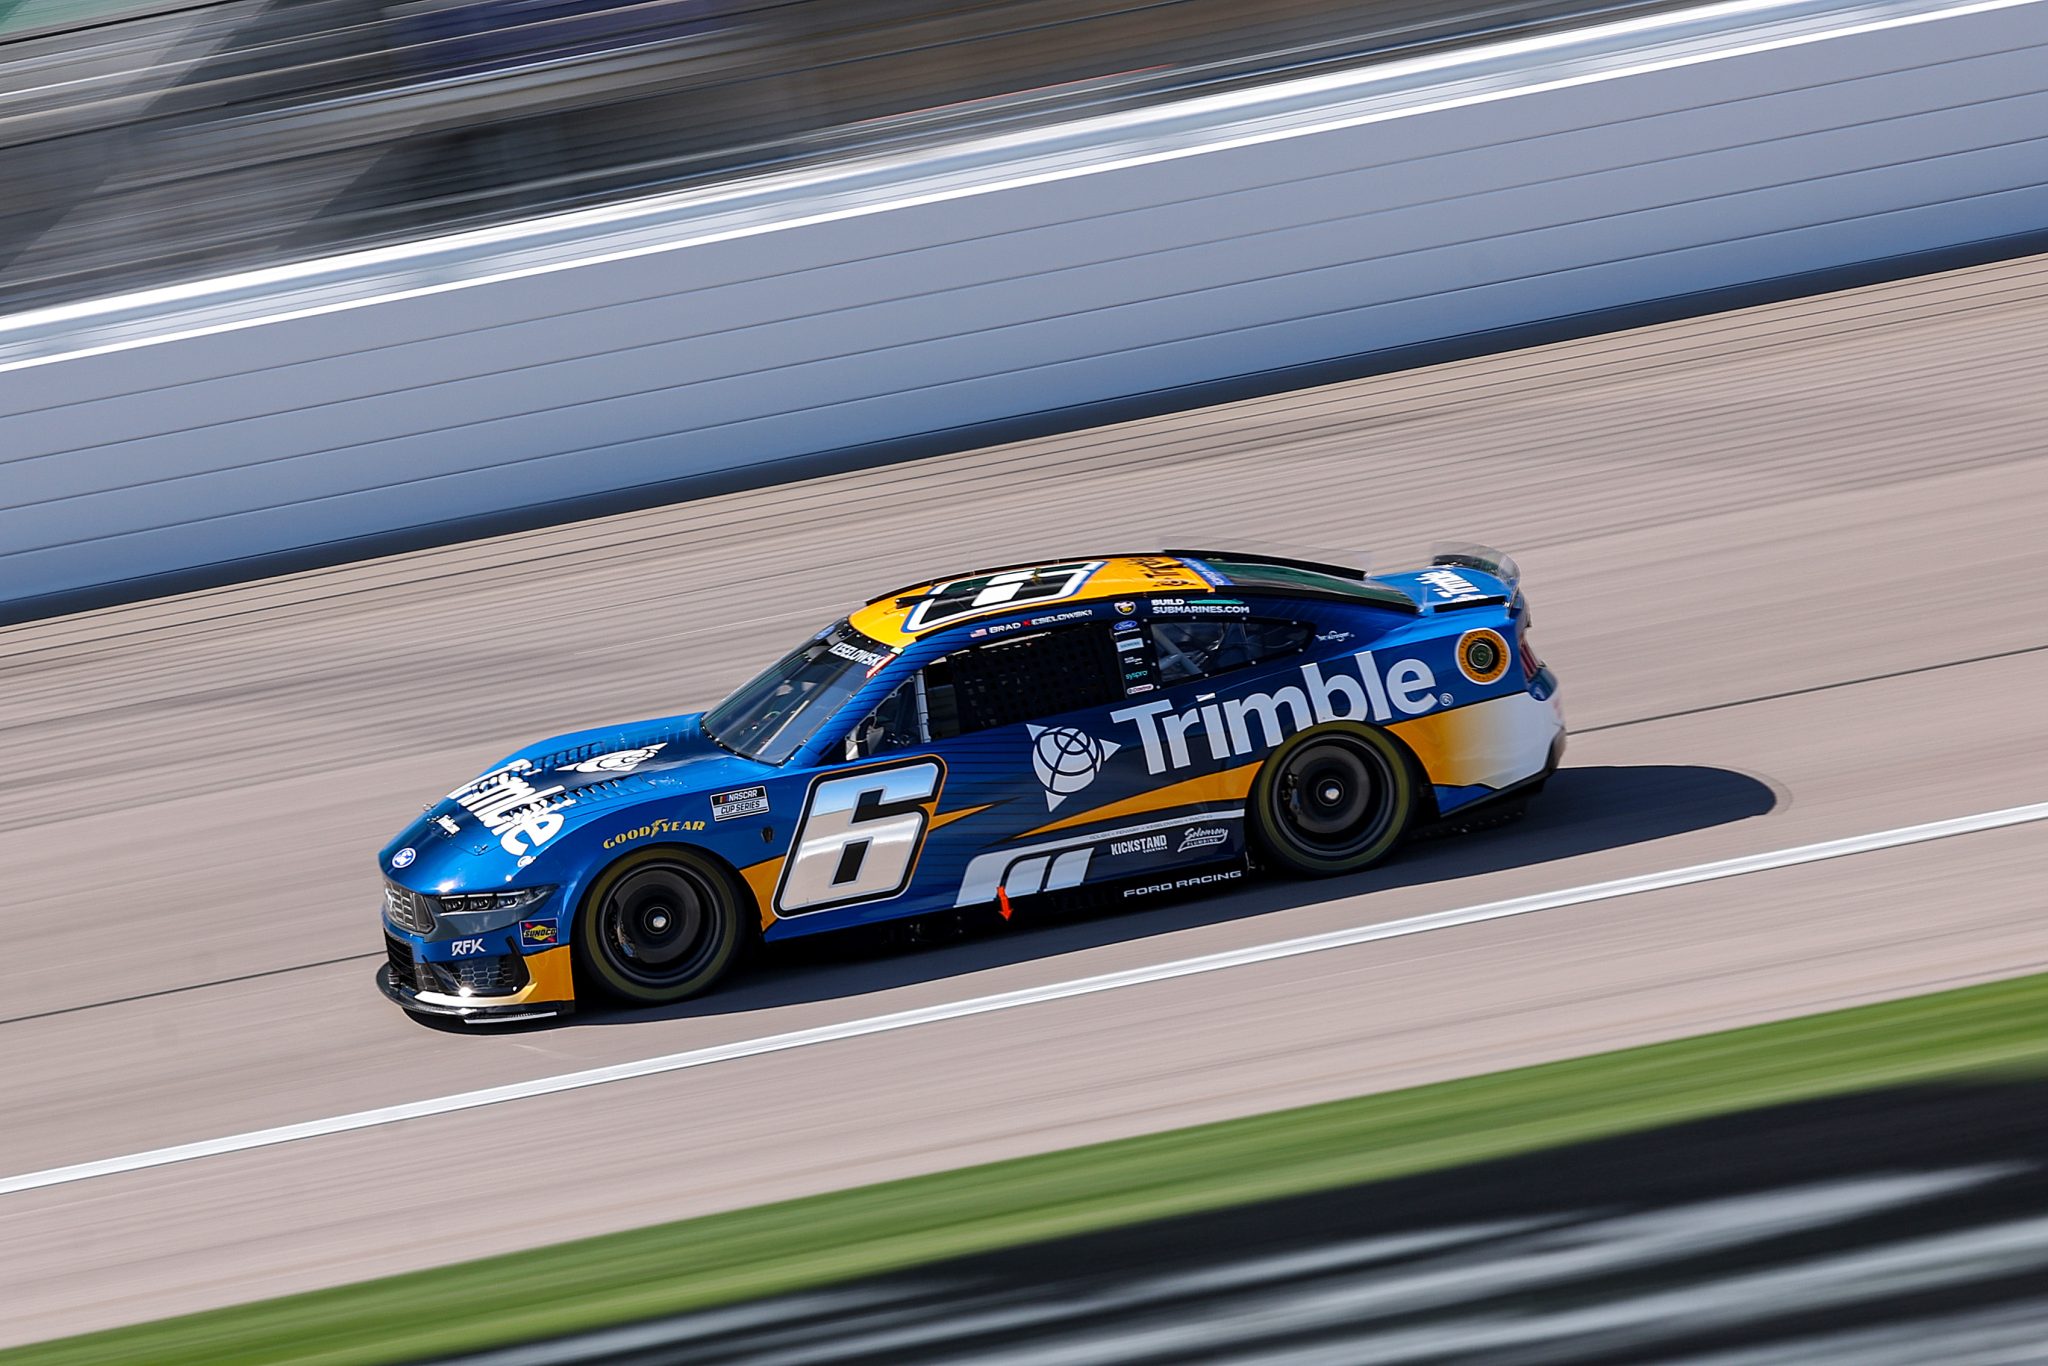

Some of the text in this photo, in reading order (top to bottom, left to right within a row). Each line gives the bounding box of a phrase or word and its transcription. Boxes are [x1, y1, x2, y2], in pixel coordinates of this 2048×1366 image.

[1151, 598, 1185, 606] BUILD
[1152, 605, 1250, 614] SUBMARINES.COM
[989, 622, 1021, 634] BRAD
[1125, 670, 1148, 680] syspro
[1109, 651, 1438, 775] Trimble
[728, 789, 758, 802] NASCAR
[721, 800, 760, 815] CUP SERIES
[776, 758, 943, 914] 6
[1110, 834, 1168, 856] KICKSTAND
[1123, 870, 1242, 898] FORD RACING
[524, 927, 557, 938] SUNOCO
[451, 938, 486, 956] RFK
